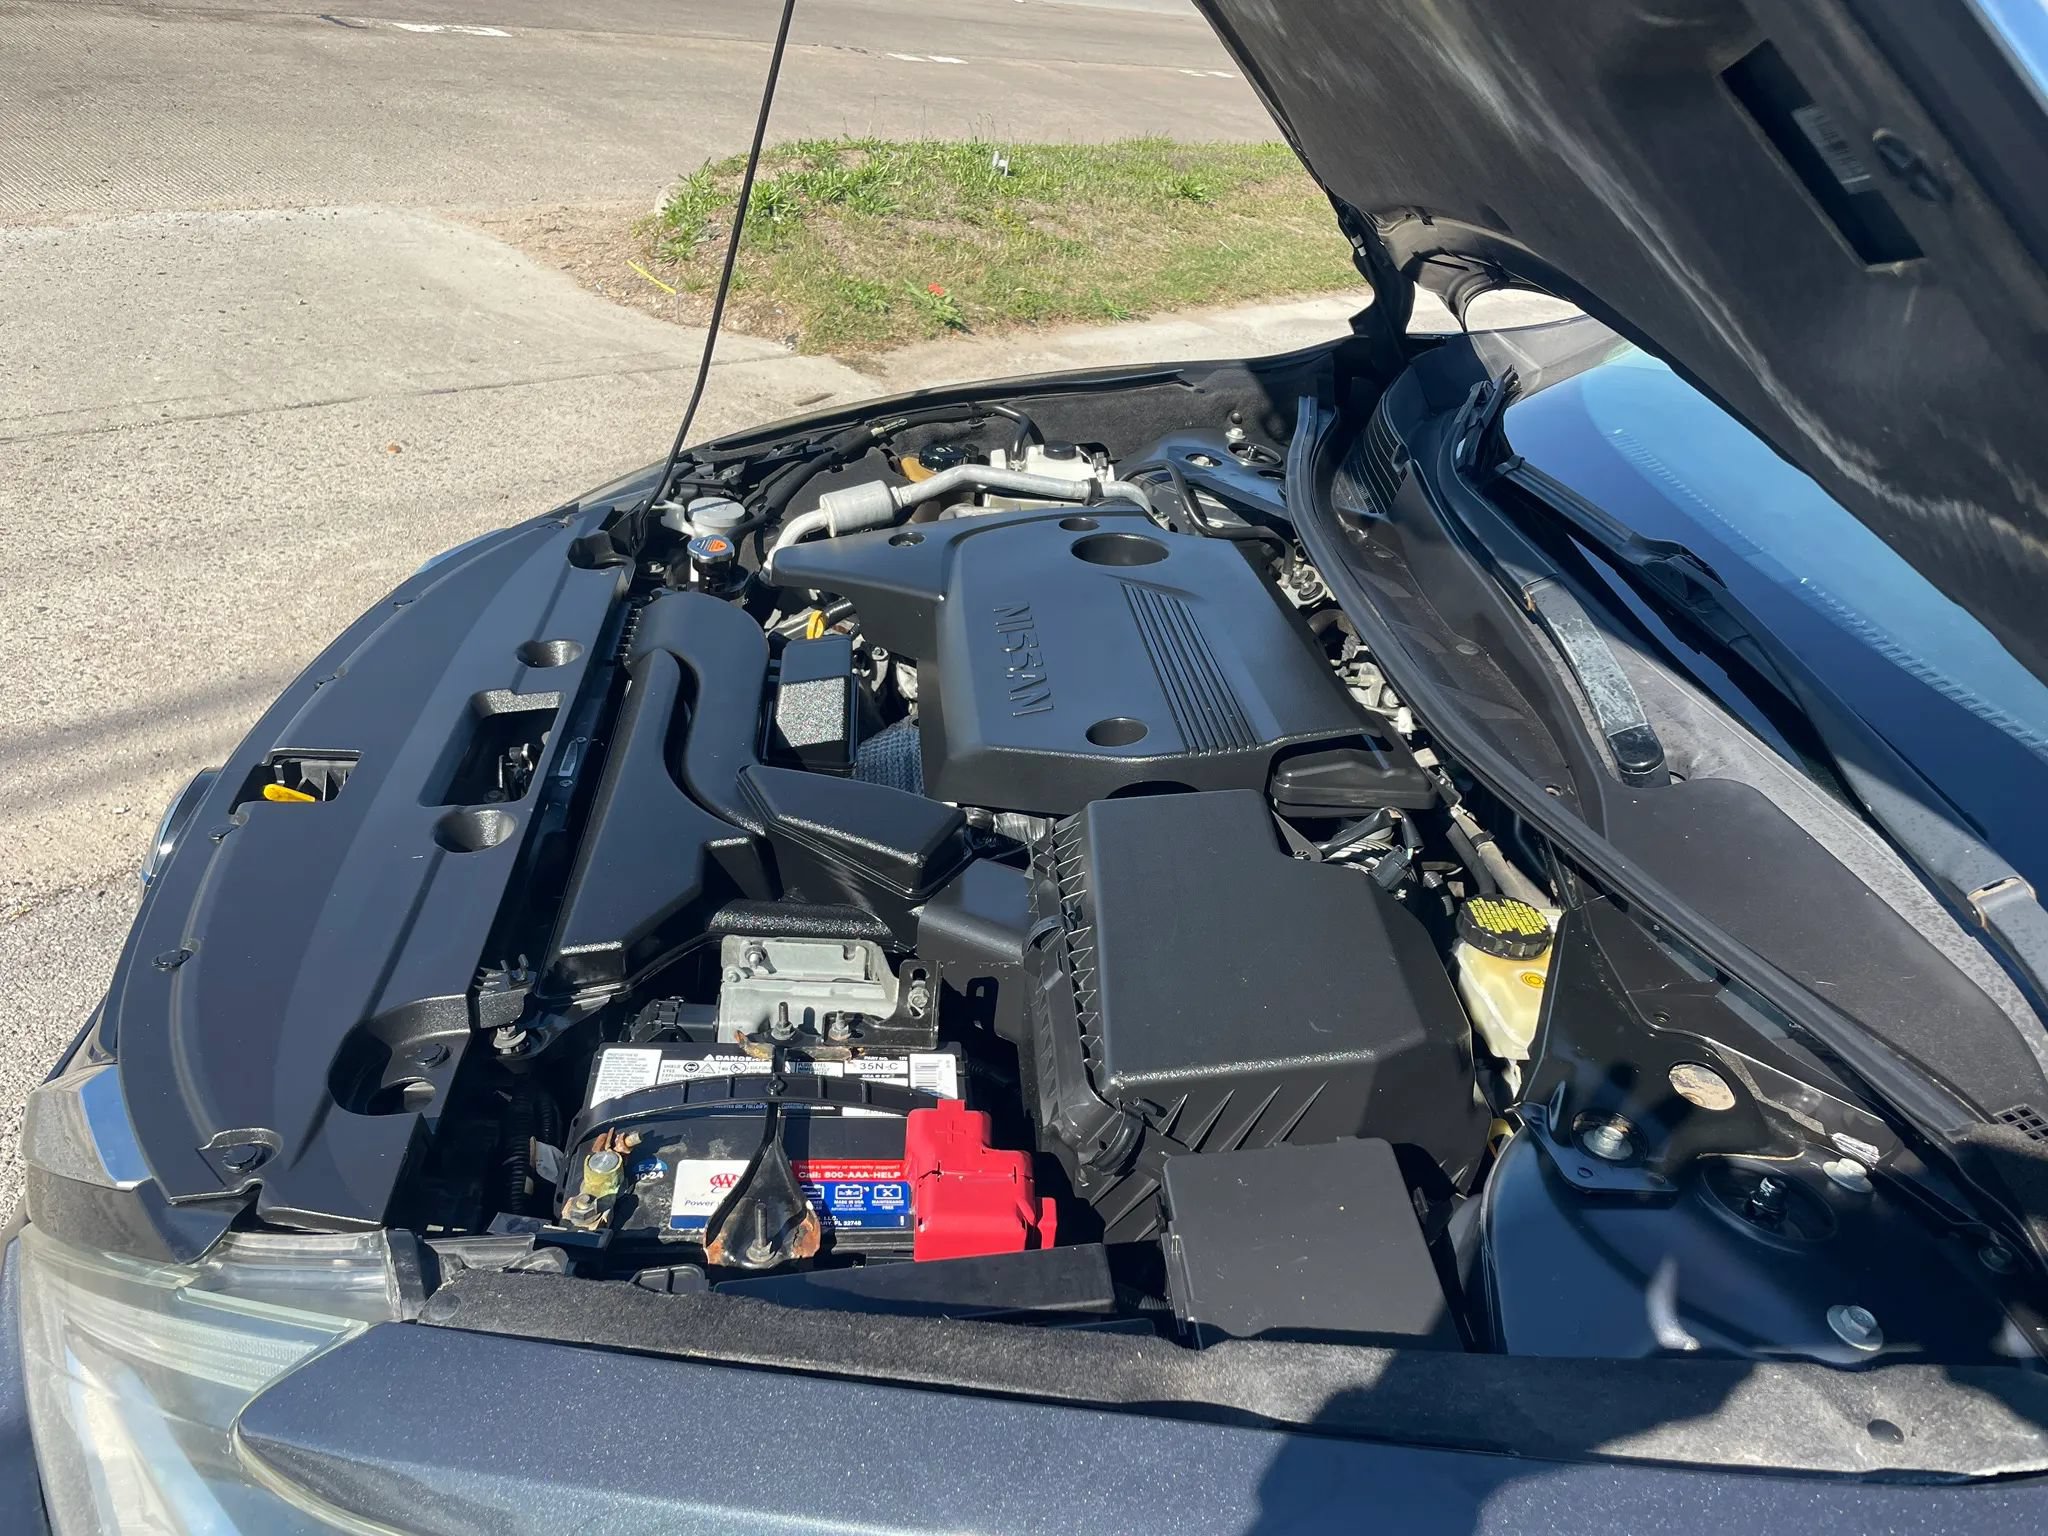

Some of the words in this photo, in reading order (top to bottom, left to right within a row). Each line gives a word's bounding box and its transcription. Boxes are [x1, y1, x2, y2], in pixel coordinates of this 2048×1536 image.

[993, 601, 1054, 717] NISSAN
[824, 1171, 901, 1179] 800-AAA-HELP
[684, 1199, 714, 1207] Power
